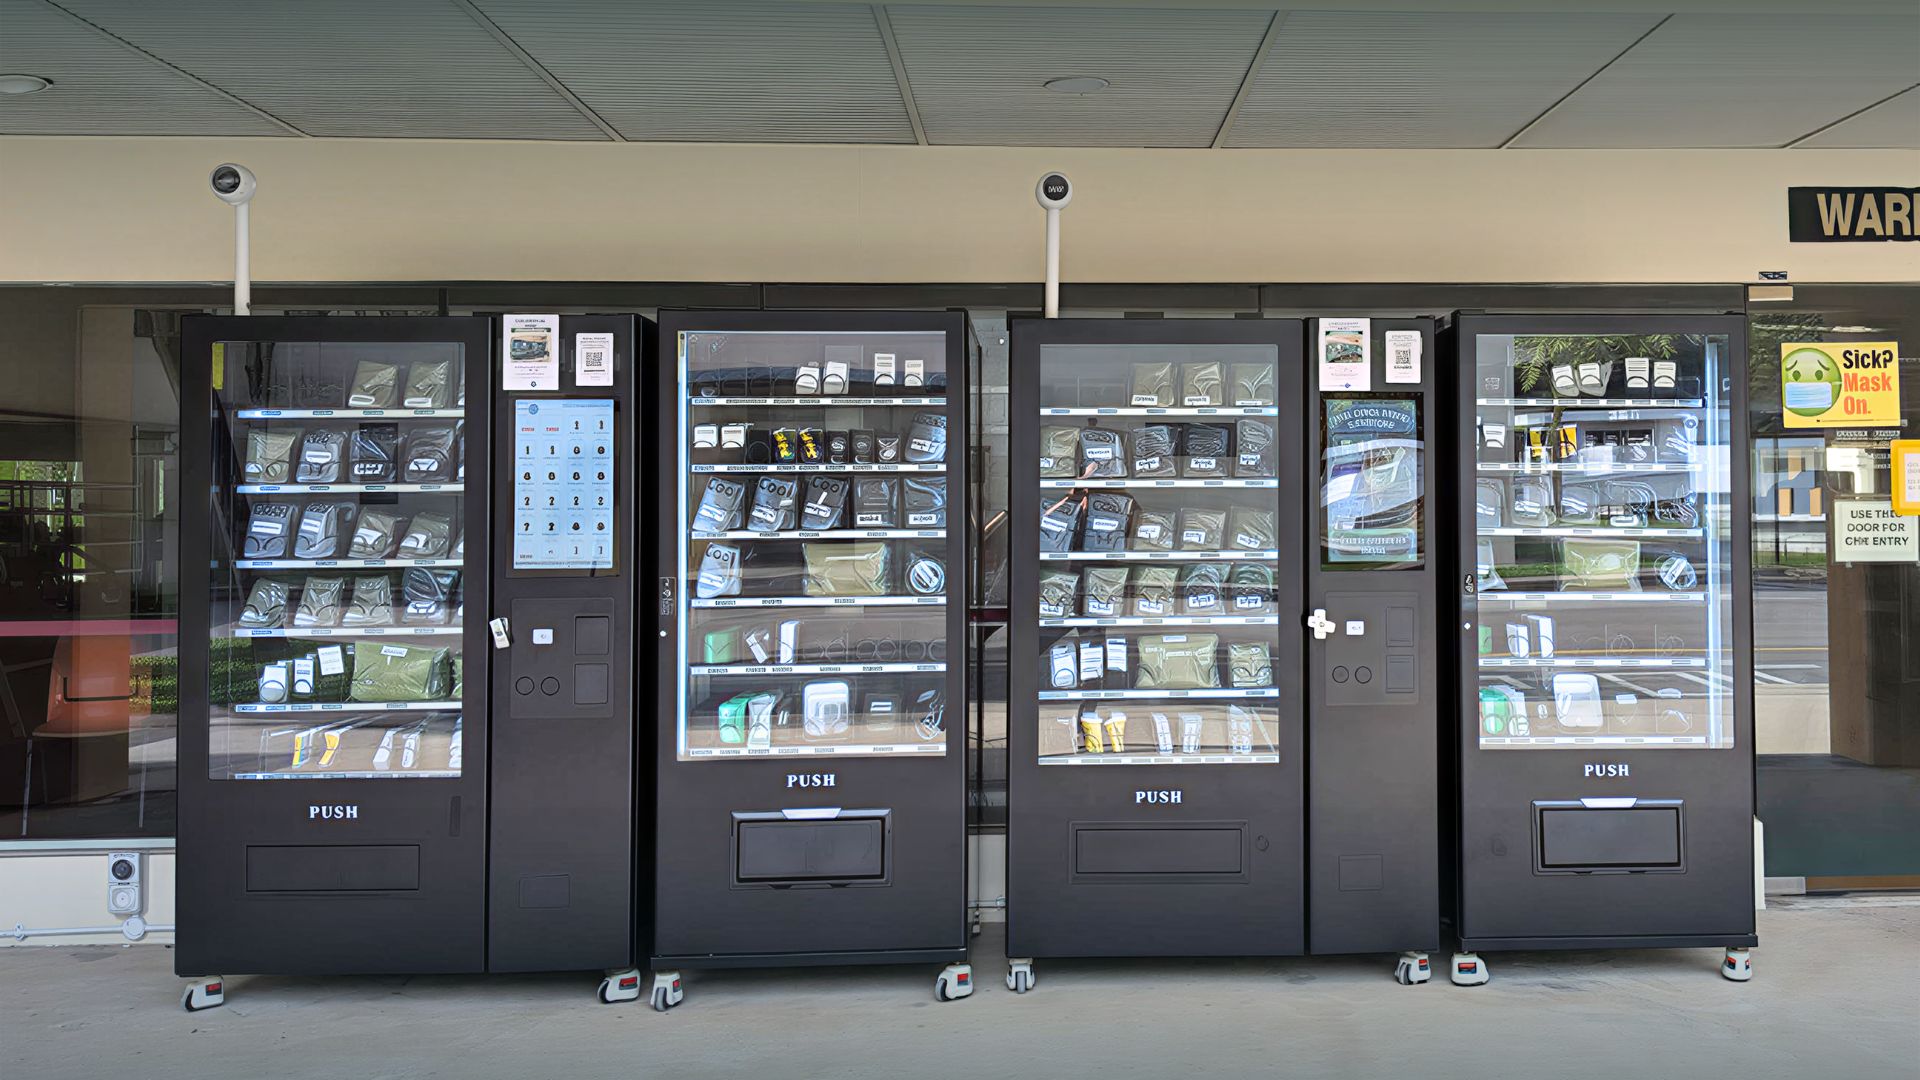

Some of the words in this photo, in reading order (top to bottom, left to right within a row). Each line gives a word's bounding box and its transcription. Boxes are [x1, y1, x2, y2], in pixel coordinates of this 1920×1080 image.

[1842, 349, 1894, 369] Sick?
[1843, 372, 1893, 392] Mask
[1843, 396, 1872, 415] On.
[1850, 509, 1873, 519] USE
[1847, 522, 1880, 532] DOOR
[1882, 522, 1905, 532] FOR
[1872, 536, 1909, 546] ENTRY
[1584, 764, 1630, 778] PUSH
[787, 773, 836, 788] PUSH
[1135, 790, 1183, 804] PUSH
[309, 805, 358, 819] PUSH
